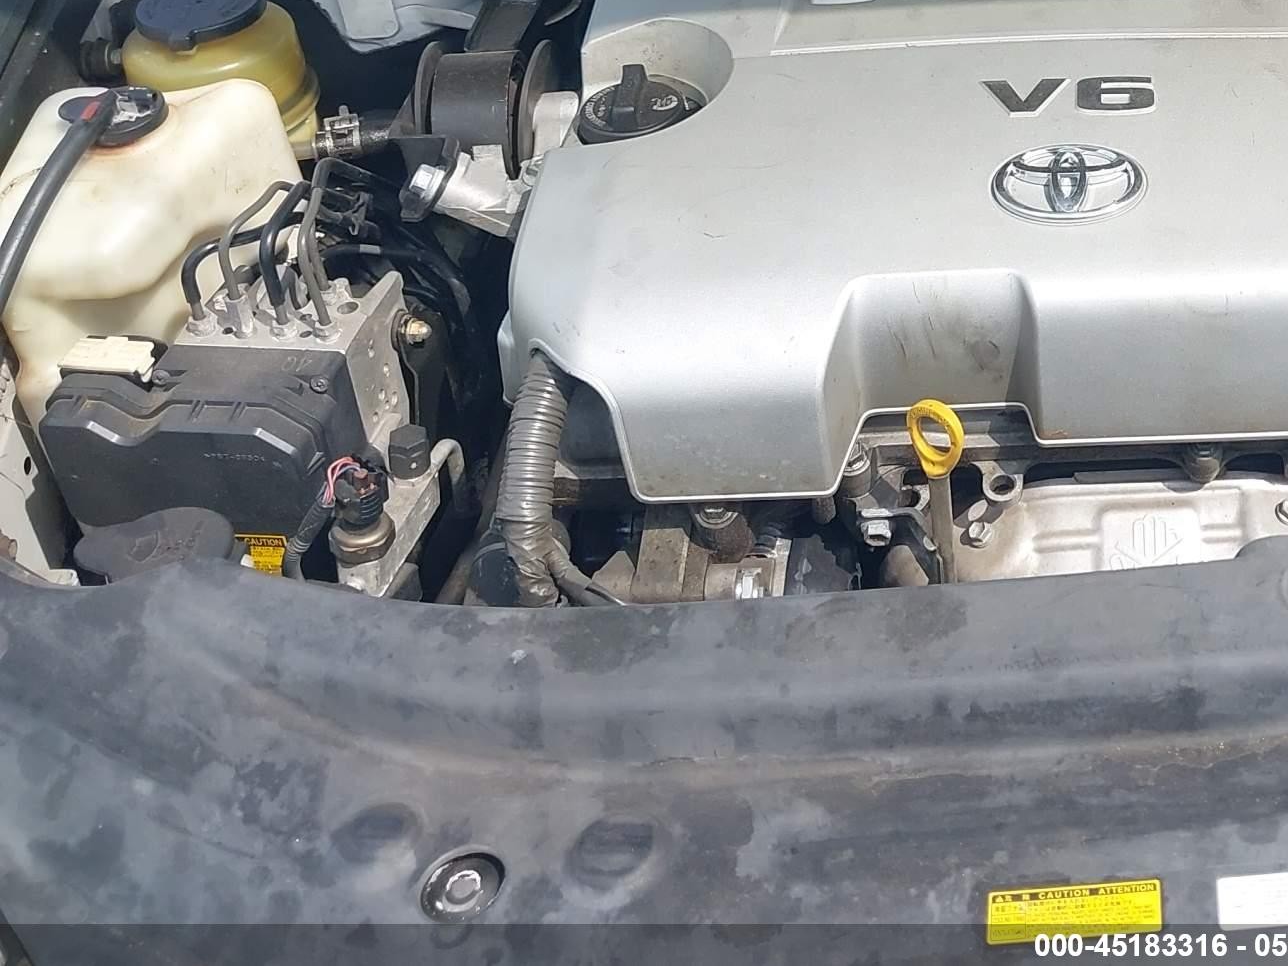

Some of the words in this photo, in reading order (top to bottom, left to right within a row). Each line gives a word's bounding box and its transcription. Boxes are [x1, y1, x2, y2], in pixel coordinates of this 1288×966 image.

[979, 76, 1156, 115] V6
[244, 537, 283, 546] CAUTION
[1038, 889, 1090, 900] CAUTION
[1098, 884, 1155, 895] ATTENTION
